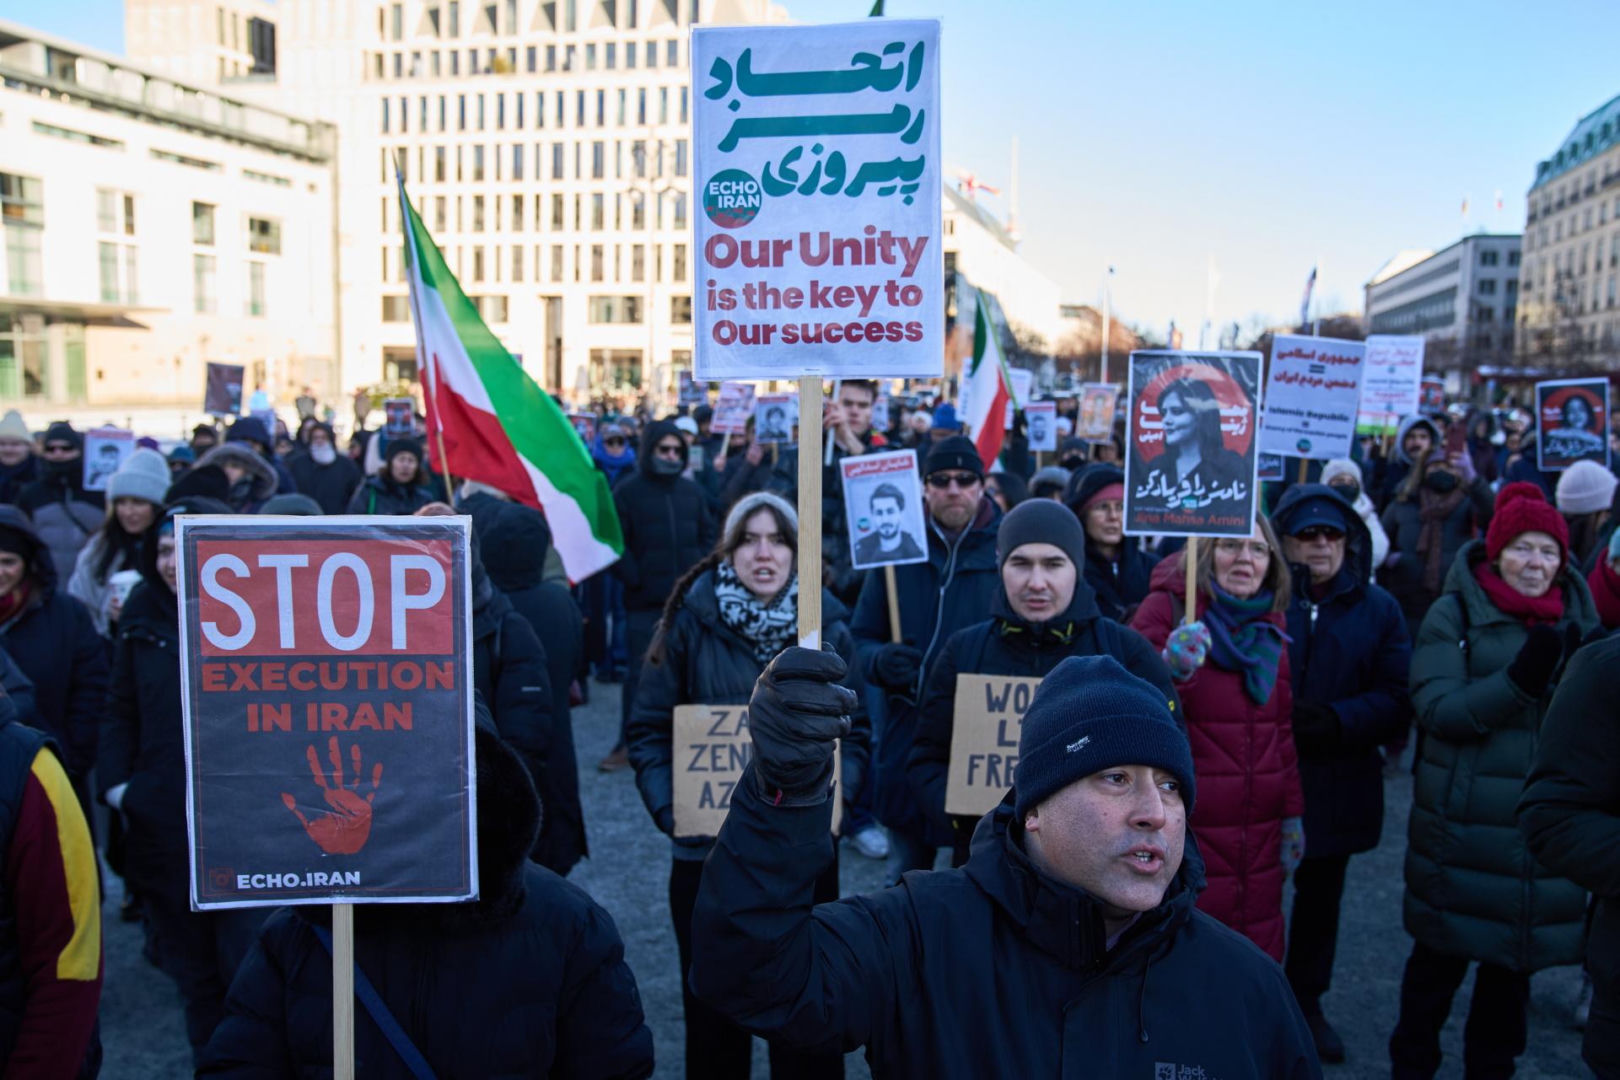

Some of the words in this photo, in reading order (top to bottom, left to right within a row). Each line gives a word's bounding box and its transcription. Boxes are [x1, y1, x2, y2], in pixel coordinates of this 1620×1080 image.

[704, 40, 926, 101] اتحاد
[717, 99, 926, 153] رمز
[709, 181, 758, 195] ECHO
[761, 143, 926, 206] پیروزی
[718, 194, 760, 209] IRAN
[704, 233, 792, 269] Our
[799, 224, 929, 278] Unity
[707, 279, 737, 312] is
[742, 280, 804, 310] the
[810, 279, 880, 318] key
[884, 280, 924, 308] to
[712, 319, 777, 346] Our
[781, 320, 924, 345] success
[200, 552, 447, 652] STOP
[202, 661, 455, 692] EXECUTION
[247, 702, 292, 732] IN
[307, 702, 413, 732] IRAN
[236, 870, 361, 890] ECHO.IRAN
[1177, 1064, 1205, 1077] Jack
